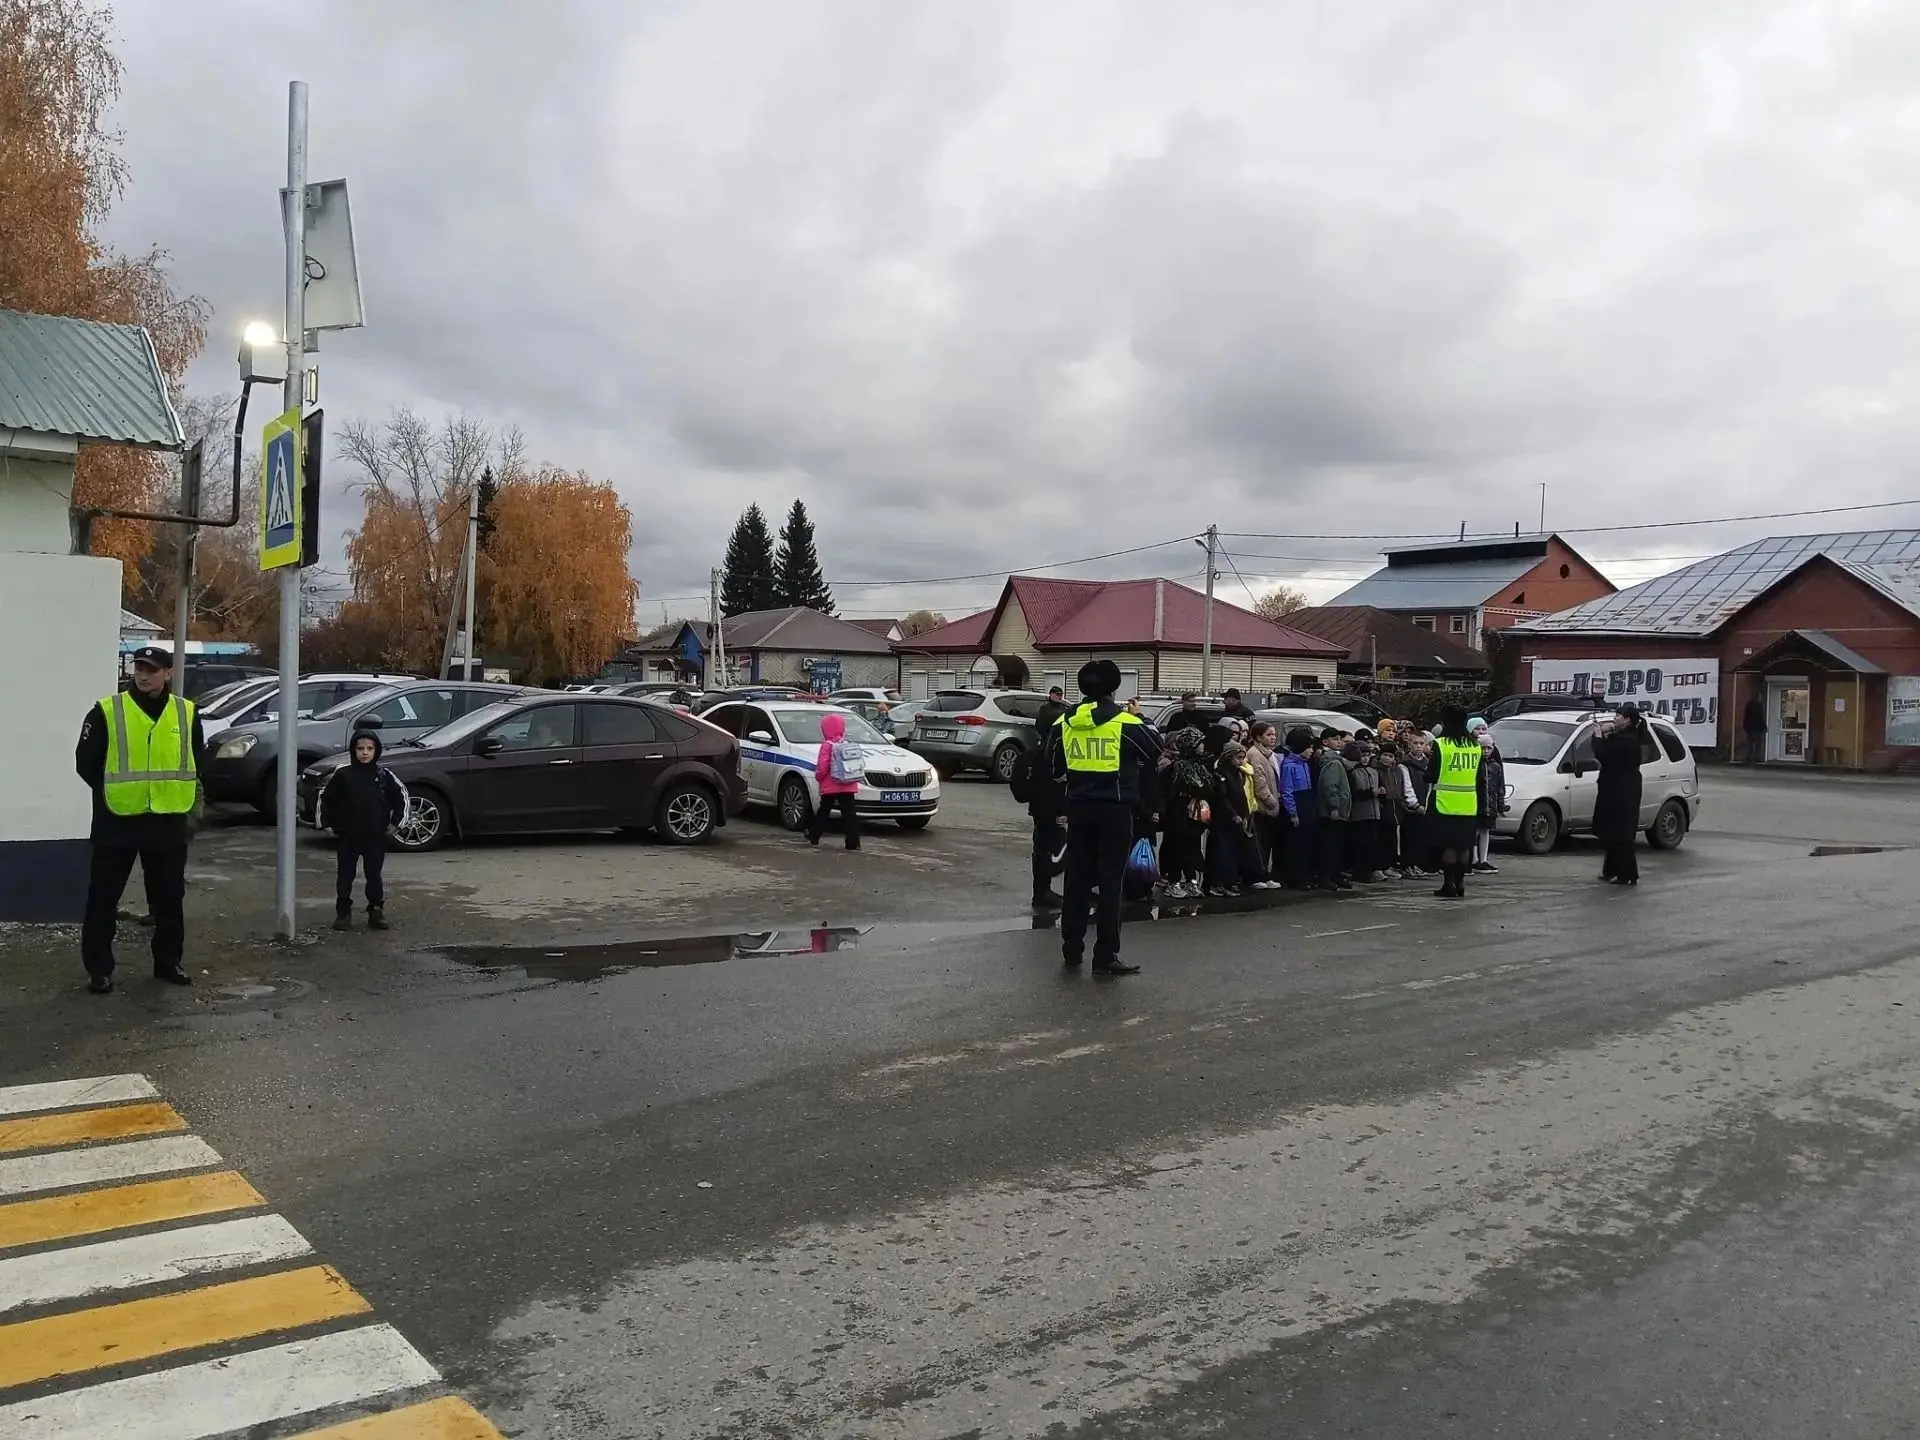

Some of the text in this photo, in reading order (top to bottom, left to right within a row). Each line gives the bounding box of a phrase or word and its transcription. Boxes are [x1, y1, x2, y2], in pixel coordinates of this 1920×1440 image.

[1571, 668, 1663, 696] ДБРО
[1069, 737, 1115, 760] ДПС
[1448, 752, 1479, 771] ДПС
